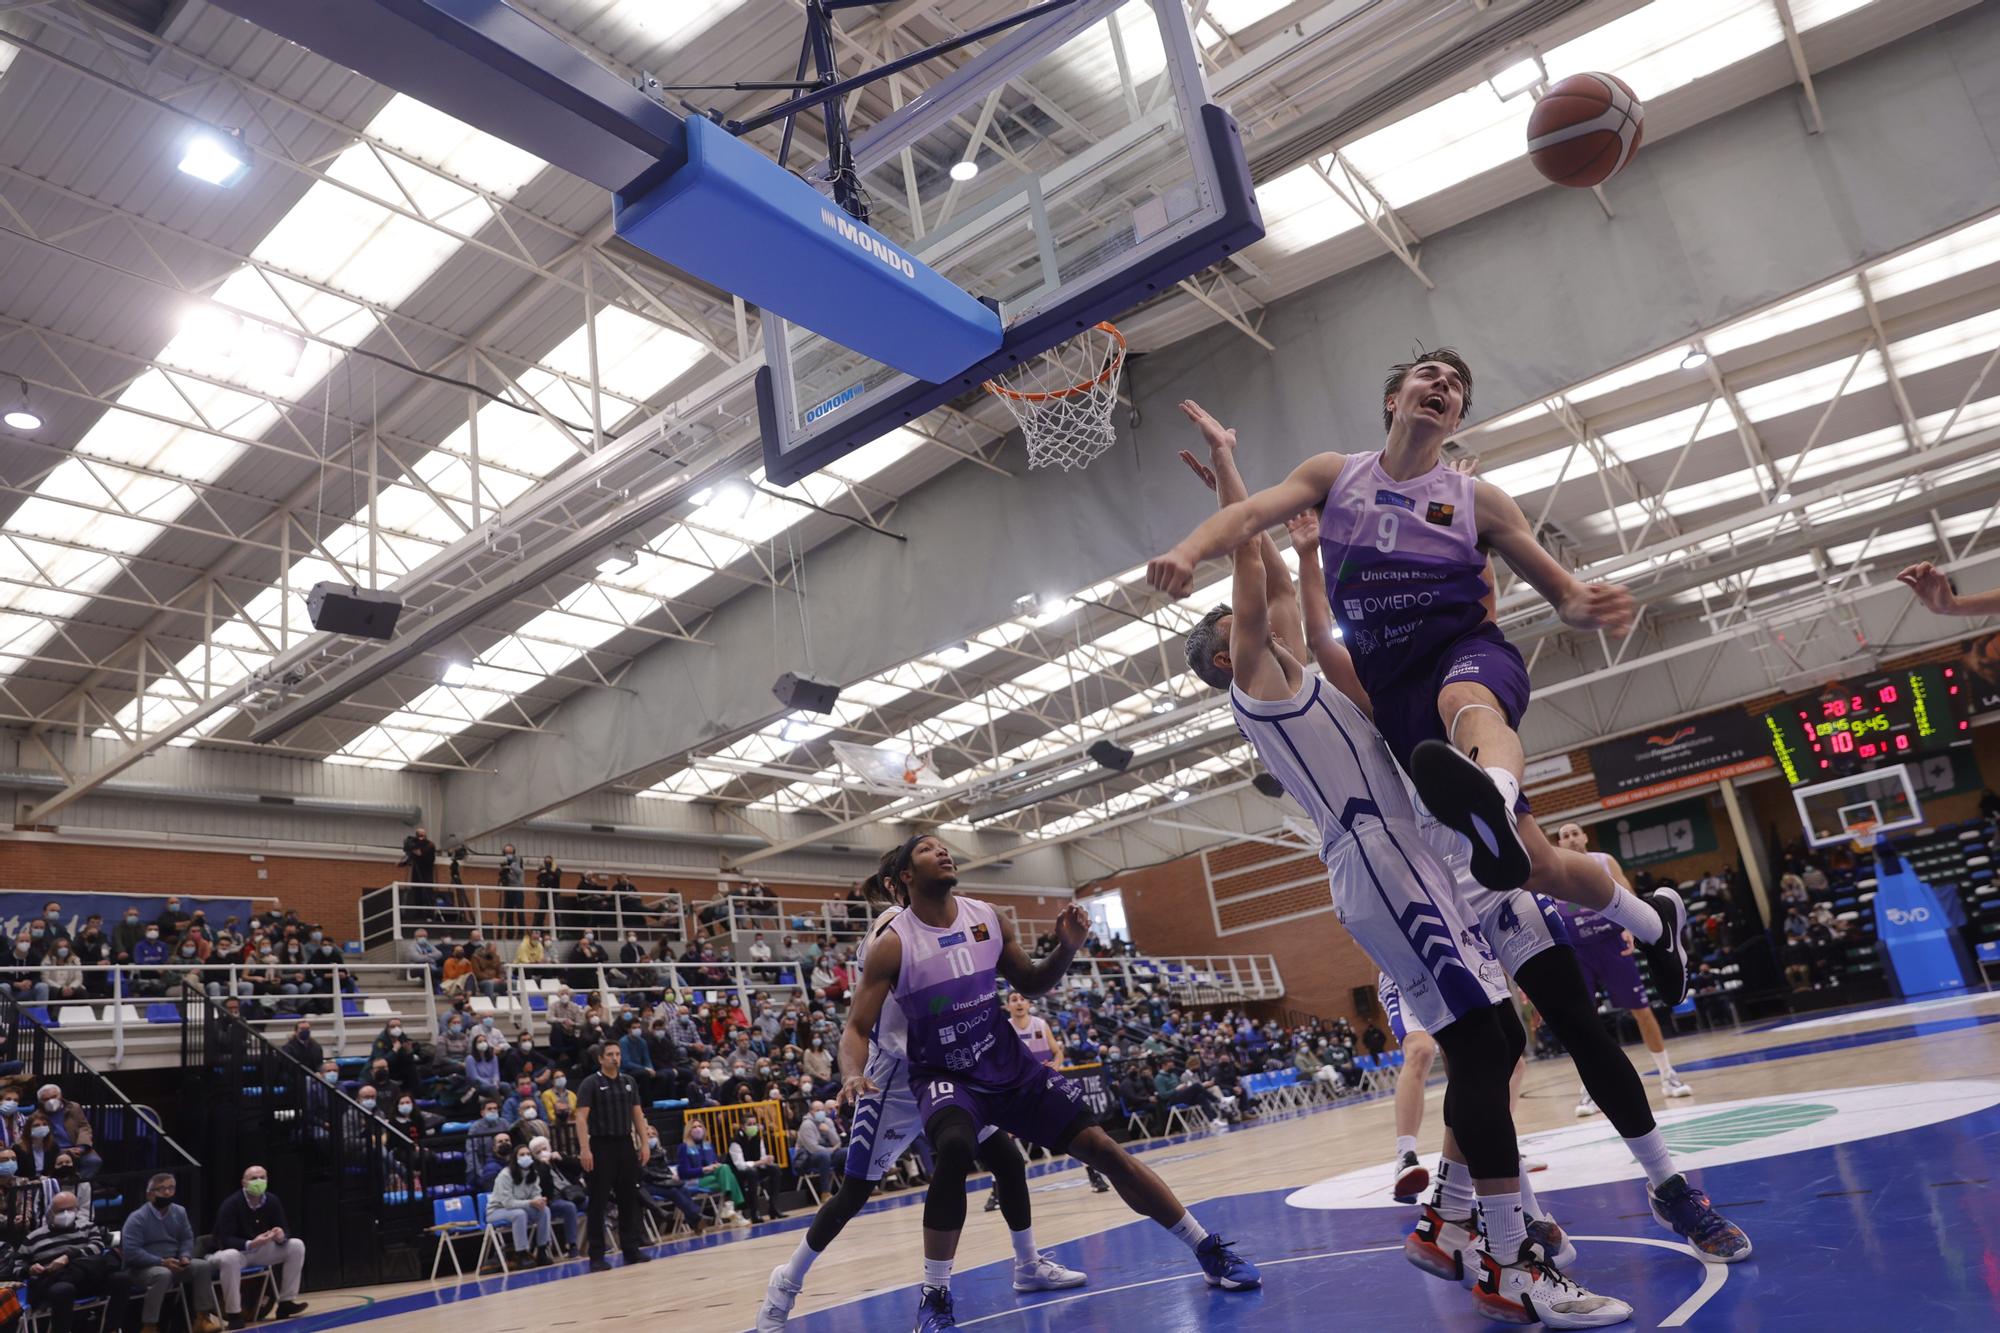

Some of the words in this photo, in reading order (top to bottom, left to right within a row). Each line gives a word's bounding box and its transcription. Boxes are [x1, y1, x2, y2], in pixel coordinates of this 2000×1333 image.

[838, 216, 915, 279] MONDO
[1375, 512, 1400, 554] 9
[1361, 571, 1409, 582] Unicaja
[1364, 592, 1433, 613] OVIEDO
[1831, 731, 1854, 753] 10
[1498, 899, 1521, 933] 4
[945, 947, 976, 979] 10
[927, 1080, 955, 1100] 10
[1082, 1075, 1103, 1094] THE
